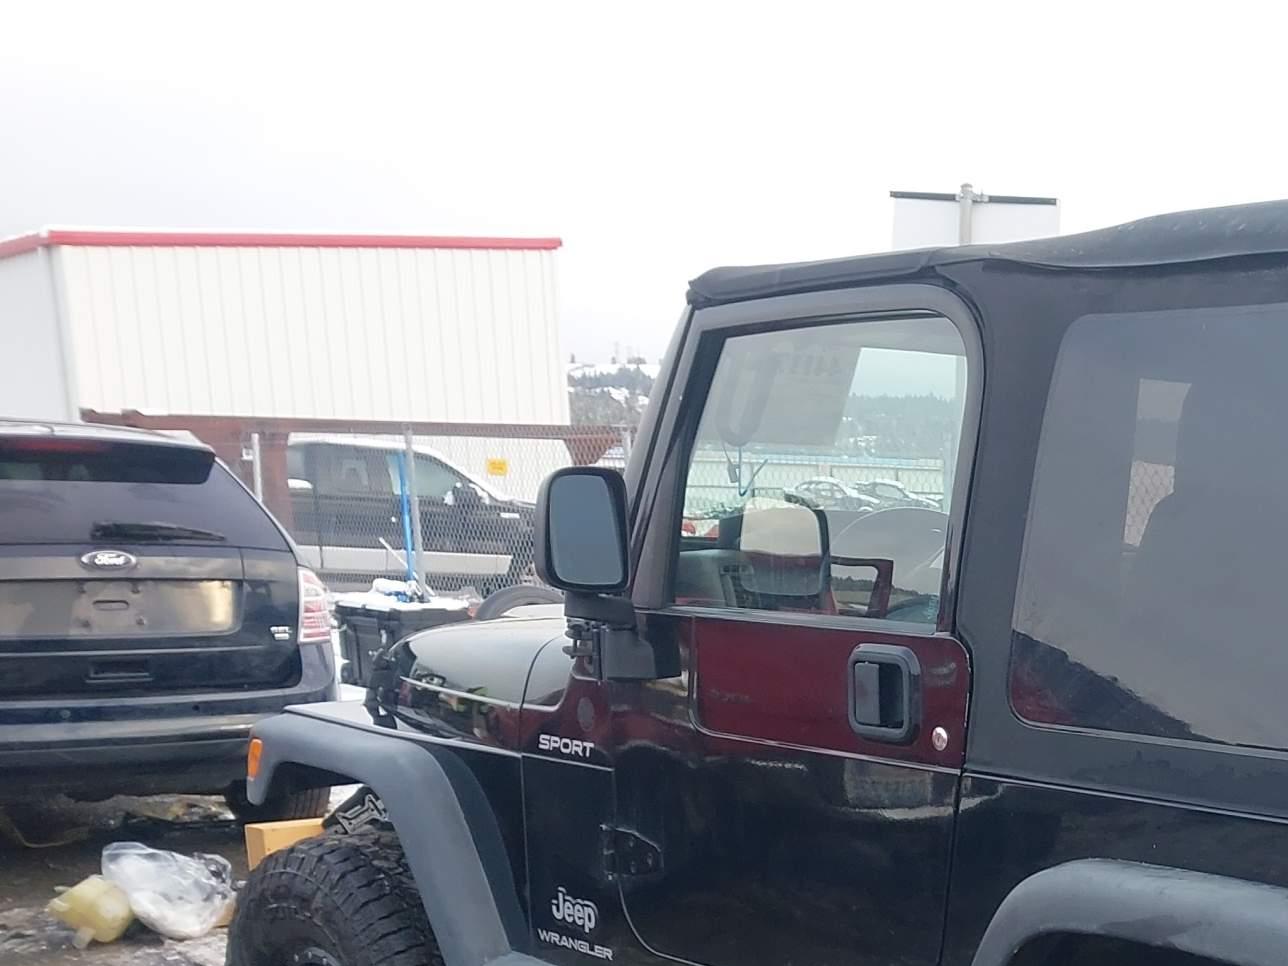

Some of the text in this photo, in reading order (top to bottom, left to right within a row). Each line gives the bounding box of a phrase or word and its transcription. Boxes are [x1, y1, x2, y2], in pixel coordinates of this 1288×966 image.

[538, 734, 595, 758] SPORT
[551, 886, 598, 933] Jeep
[537, 928, 614, 961] WRANGLER
